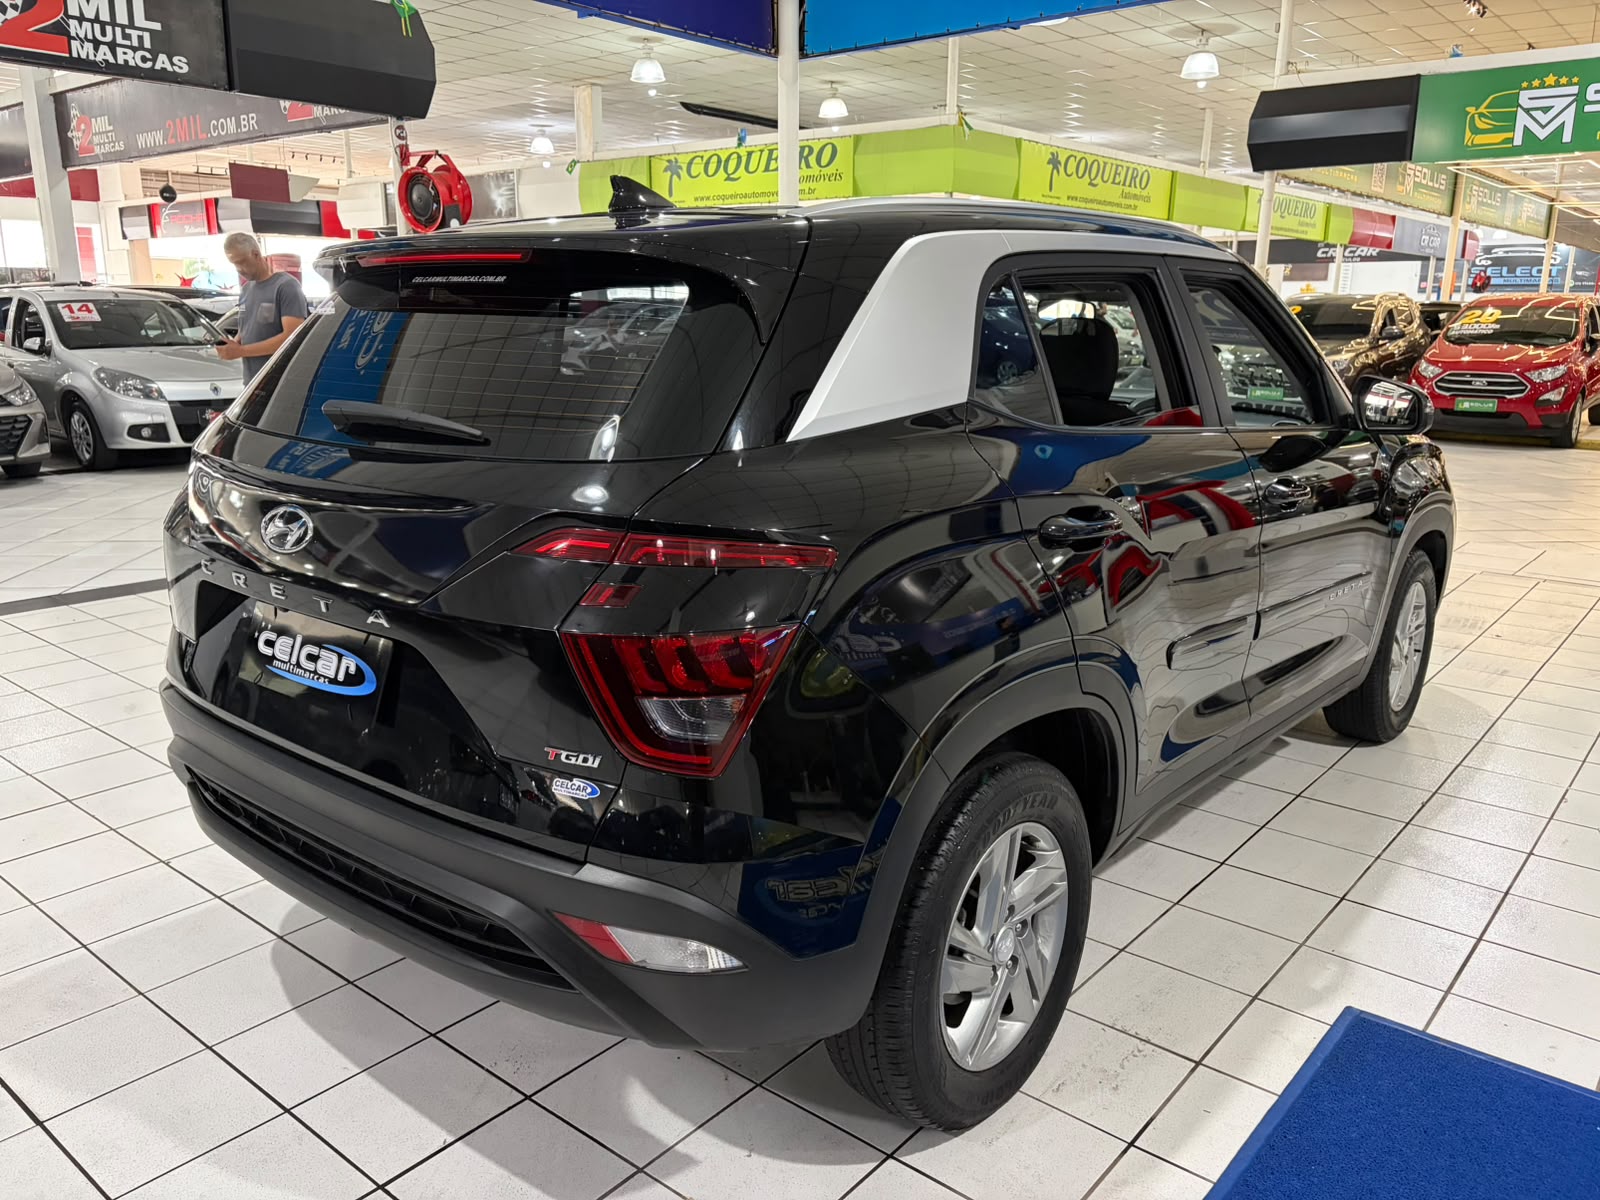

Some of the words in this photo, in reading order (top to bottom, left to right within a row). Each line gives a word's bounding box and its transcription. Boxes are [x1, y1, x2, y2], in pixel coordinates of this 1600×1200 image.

[69, 18, 151, 49] MULTI
[70, 40, 189, 74] MARCAS
[91, 116, 113, 133] MIL
[93, 132, 115, 145] MULTI
[686, 142, 838, 182] COQUERO
[1063, 154, 1151, 190] COQUEIRO
[798, 168, 844, 183] omóveis
[1414, 165, 1447, 190] SOLUS
[1272, 195, 1317, 219] OQUEIRO
[1344, 246, 1380, 257] CAR
[62, 303, 94, 315] 14
[201, 558, 390, 628] CRETA
[257, 630, 356, 682] celcar
[272, 657, 330, 685] multimarcas
[555, 780, 588, 793] CELCAR
